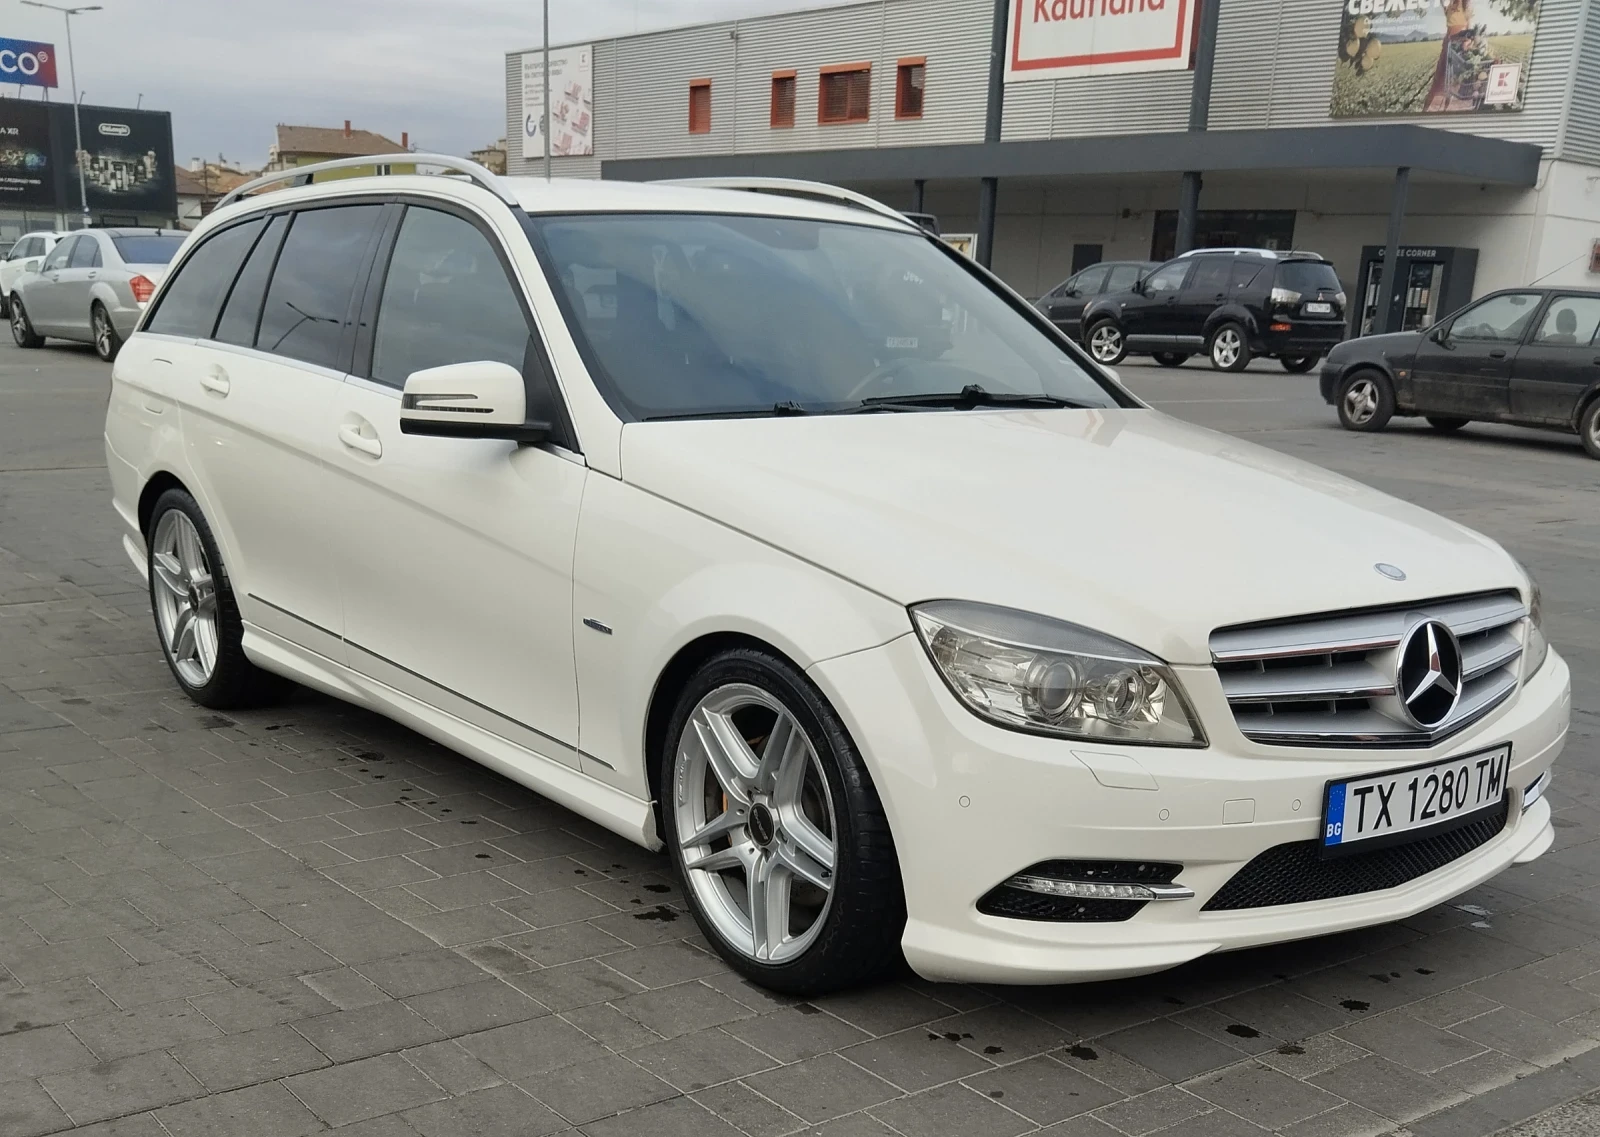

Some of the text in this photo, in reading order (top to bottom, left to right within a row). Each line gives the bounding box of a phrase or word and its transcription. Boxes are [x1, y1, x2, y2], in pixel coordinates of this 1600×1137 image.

[1406, 249, 1437, 257] CORNER
[1353, 754, 1504, 833] TX 1280 TM
[1326, 822, 1342, 838] BG
